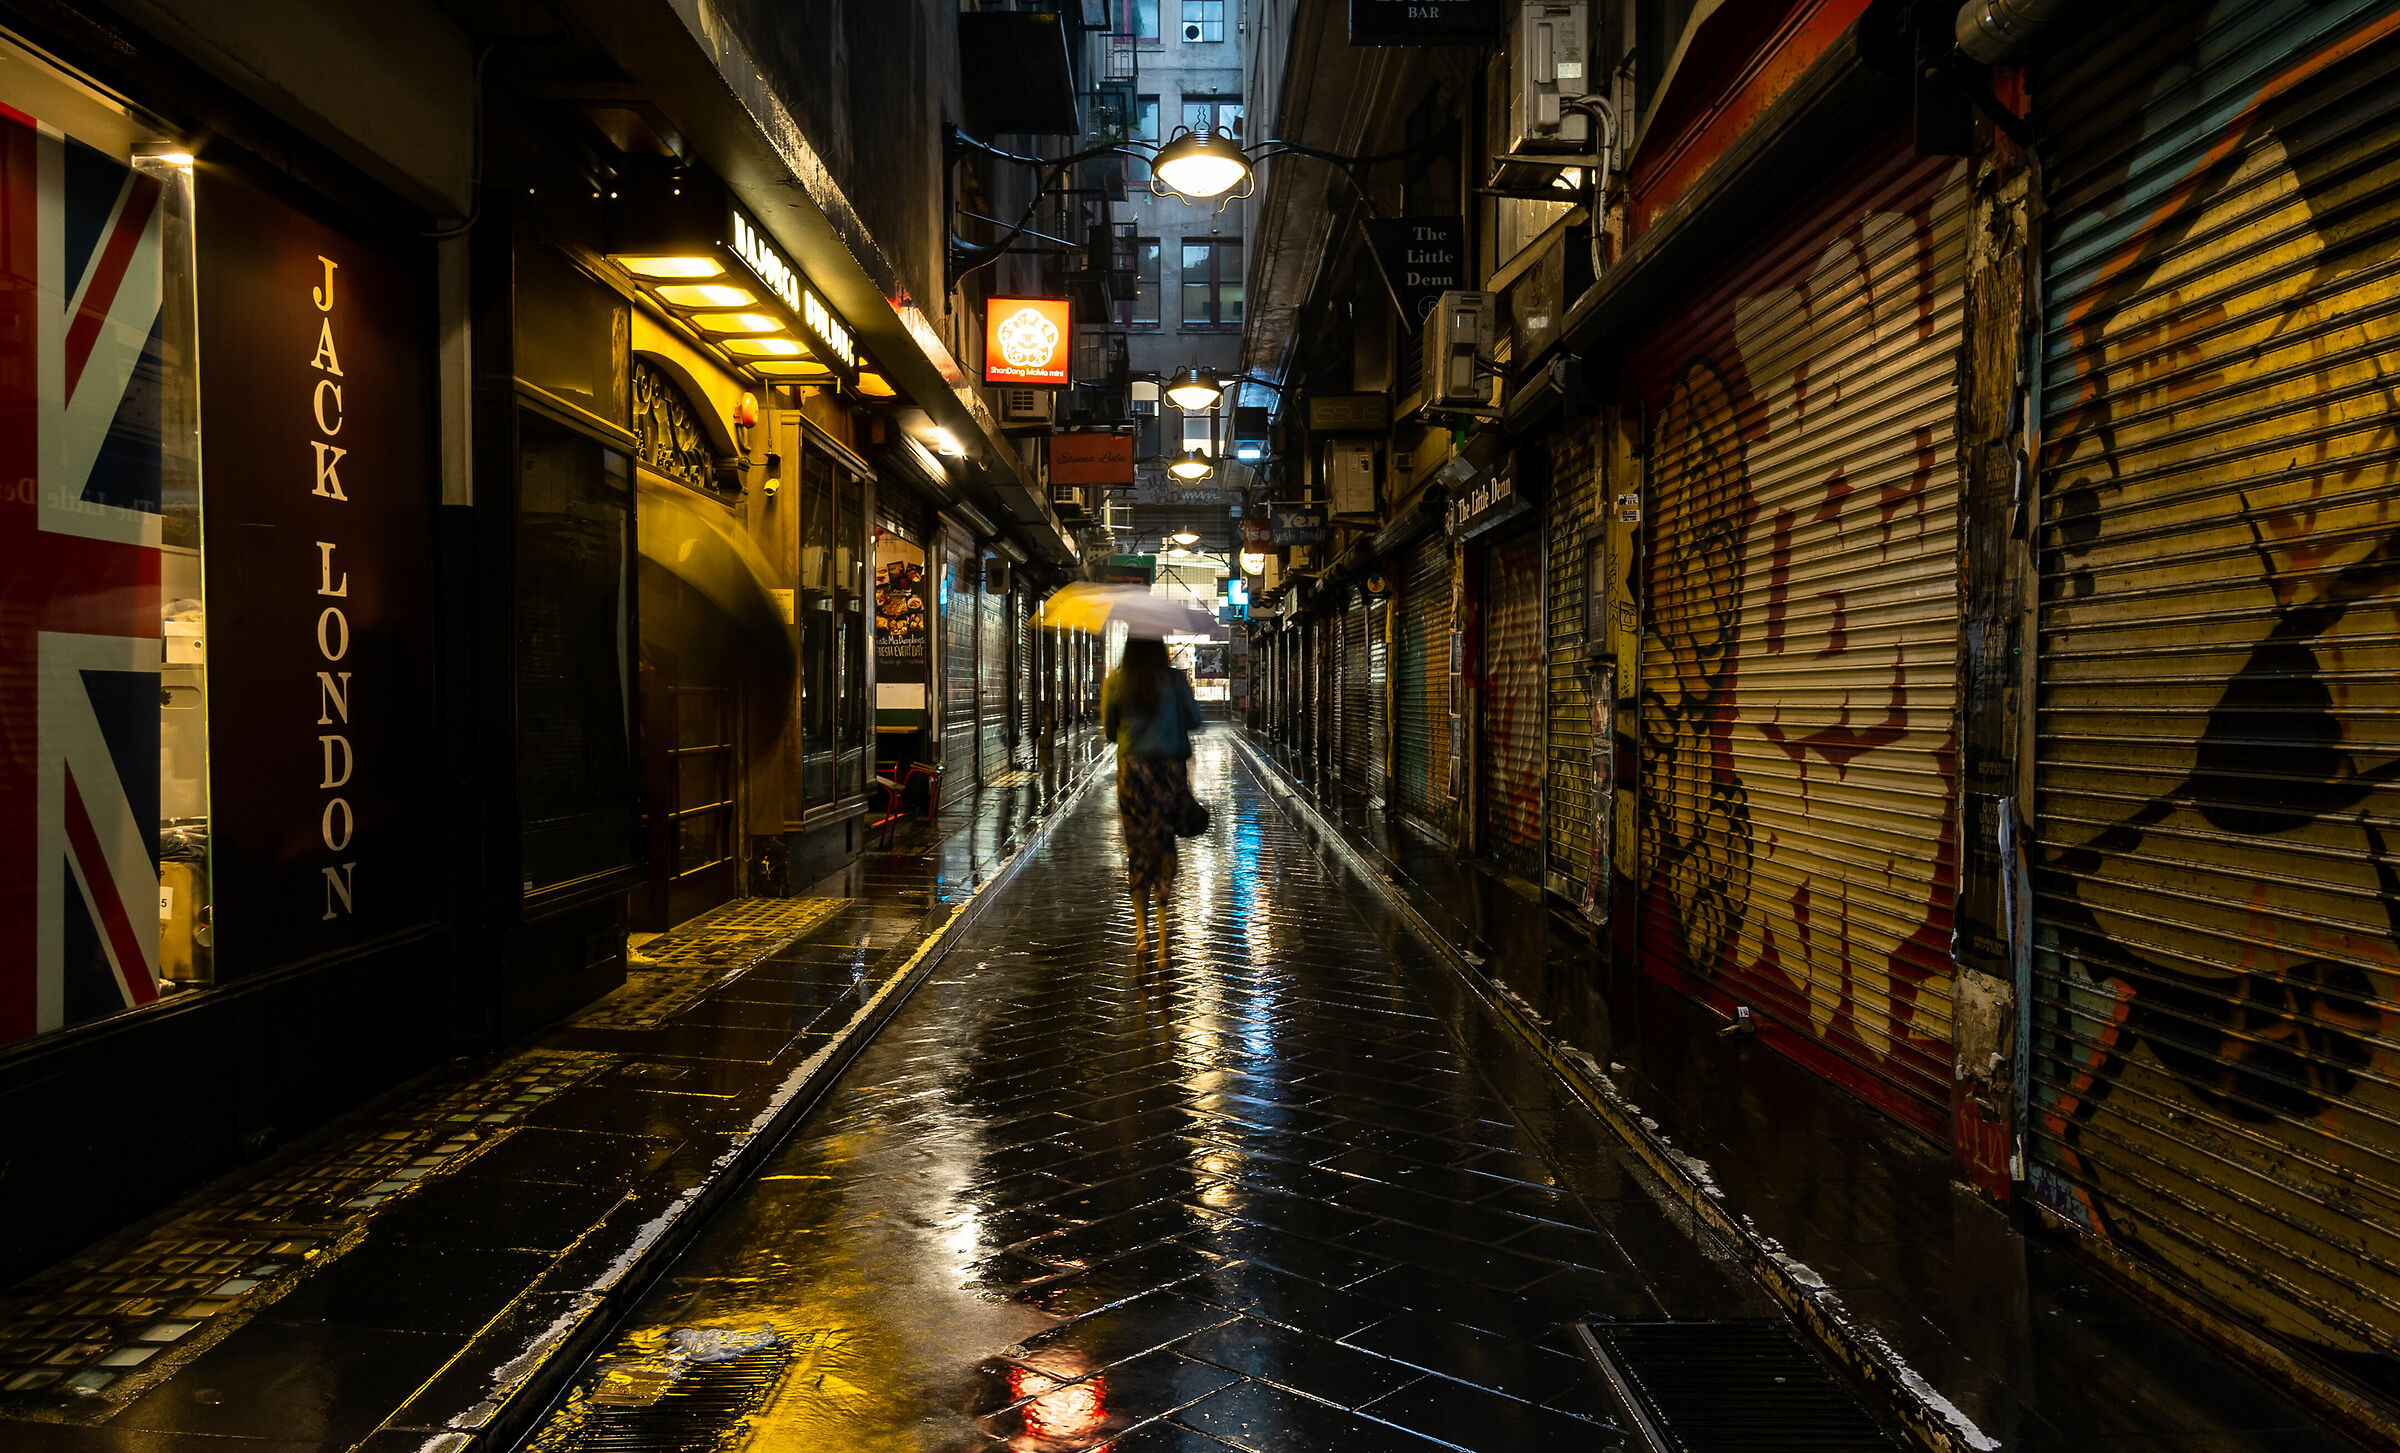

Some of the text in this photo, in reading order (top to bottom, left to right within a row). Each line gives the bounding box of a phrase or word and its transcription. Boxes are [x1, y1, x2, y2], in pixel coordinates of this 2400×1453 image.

[1407, 6, 1439, 19] BAR
[1412, 226, 1449, 241] The
[734, 210, 800, 313] MAJORCA
[1407, 249, 1455, 264] Little
[1406, 272, 1454, 287] Denn
[990, 366, 1026, 378] ShanDong
[1026, 367, 1048, 376] MaMa
[1458, 476, 1511, 524] The Little Denn
[1278, 513, 1321, 528] Yen
[310, 254, 357, 921] JACK LONDON
[894, 646, 911, 656] EVERY
[912, 645, 924, 656] DAY
